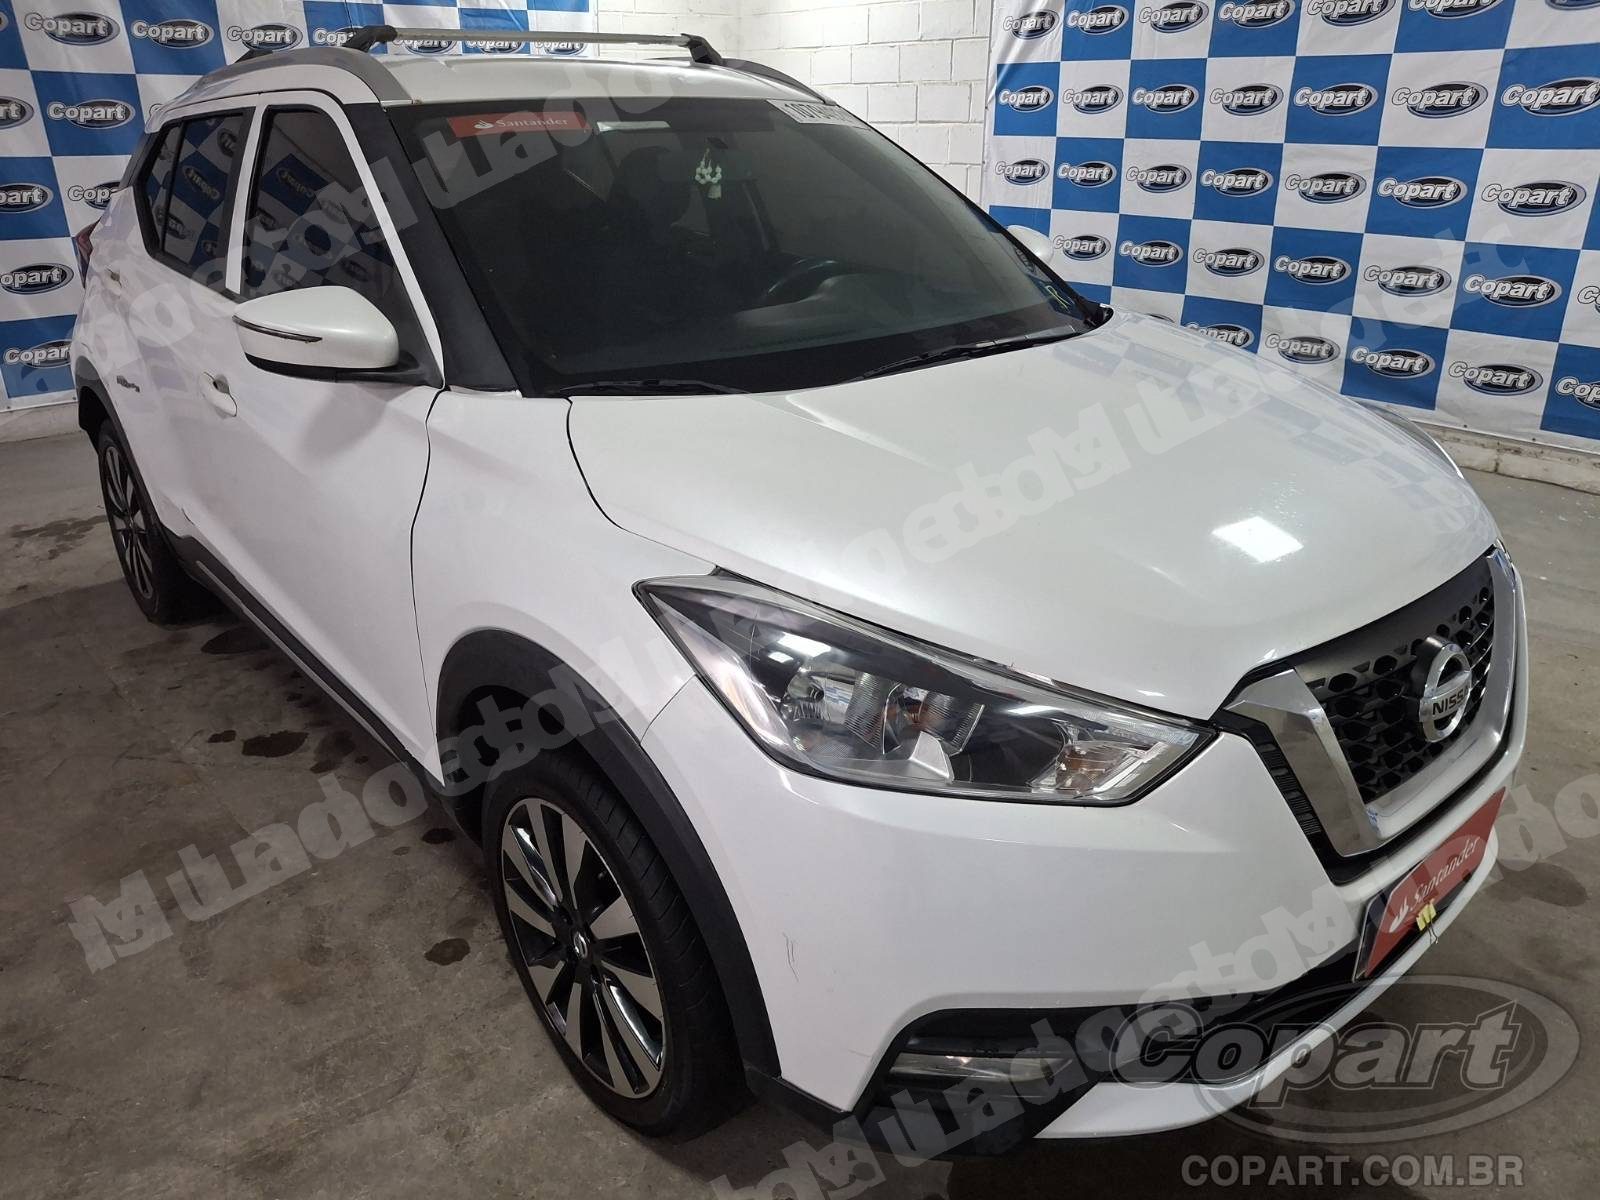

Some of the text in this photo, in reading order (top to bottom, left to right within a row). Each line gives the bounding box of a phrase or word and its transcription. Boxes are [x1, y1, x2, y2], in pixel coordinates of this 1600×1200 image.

[1067, 9, 1123, 28] Copart
[1139, 4, 1199, 26] Copart
[1219, 1, 1289, 21] Copart
[1307, 0, 1382, 18] Copart
[24, 12, 108, 36] Copart
[132, 20, 205, 43] Copart
[1003, 17, 1052, 32] Copart
[227, 25, 292, 46] Copart
[313, 27, 354, 47] Cop
[1000, 89, 1047, 105] Copart
[1063, 88, 1118, 107] Copart
[1132, 87, 1190, 107] Copart
[1210, 88, 1274, 108] Copart
[1294, 87, 1368, 110] Copart
[1392, 87, 1475, 109] Copart
[1502, 83, 1600, 110] Copart
[47, 102, 131, 123] Copart
[495, 117, 569, 128] Santander
[995, 161, 1043, 178] Copart
[1058, 163, 1110, 180] Copart
[1126, 166, 1183, 187] Copart
[1200, 170, 1265, 192] Copart
[1285, 174, 1356, 196] Copart
[1378, 178, 1457, 201] Copart
[0, 187, 43, 205] part
[68, 185, 113, 202] Cop
[1482, 184, 1570, 208] Copart
[1053, 235, 1104, 254] Copart
[1120, 241, 1177, 260] Copart
[1193, 248, 1255, 270] Copart
[1273, 255, 1343, 279] Copart
[0, 266, 62, 284] opart
[1364, 265, 1440, 289] Copart
[1464, 274, 1551, 300] Copart
[5, 344, 70, 366] Copar
[1265, 334, 1331, 357] Copart
[1351, 347, 1425, 375] Copart
[1449, 361, 1533, 389] Copart
[1555, 376, 1600, 403] Cop
[1413, 836, 1481, 903] Santander
